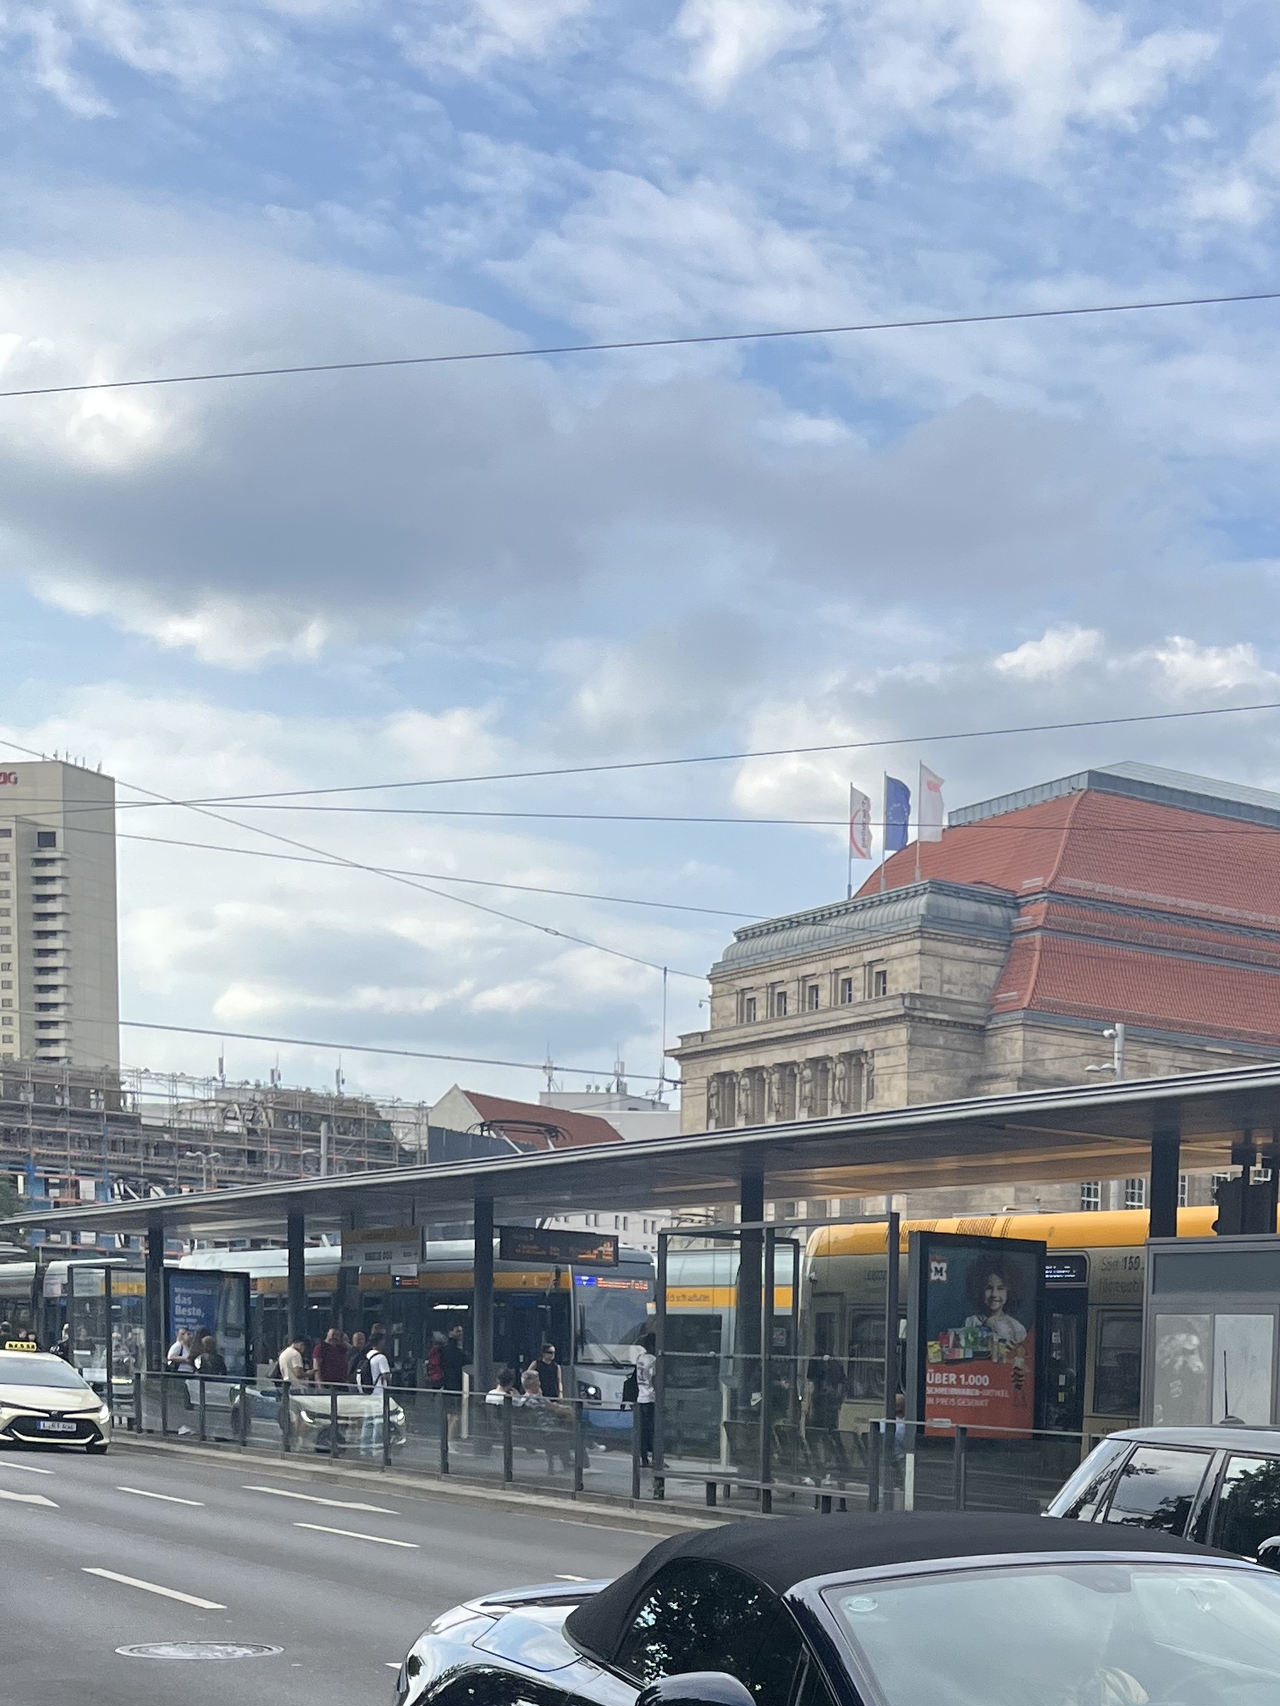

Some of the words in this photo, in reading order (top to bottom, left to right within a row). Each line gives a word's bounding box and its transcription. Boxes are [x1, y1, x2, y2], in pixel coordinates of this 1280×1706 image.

[174, 1293, 192, 1305] das
[926, 1368, 957, 1386] ÜBER
[959, 1374, 990, 1386] 1.000
